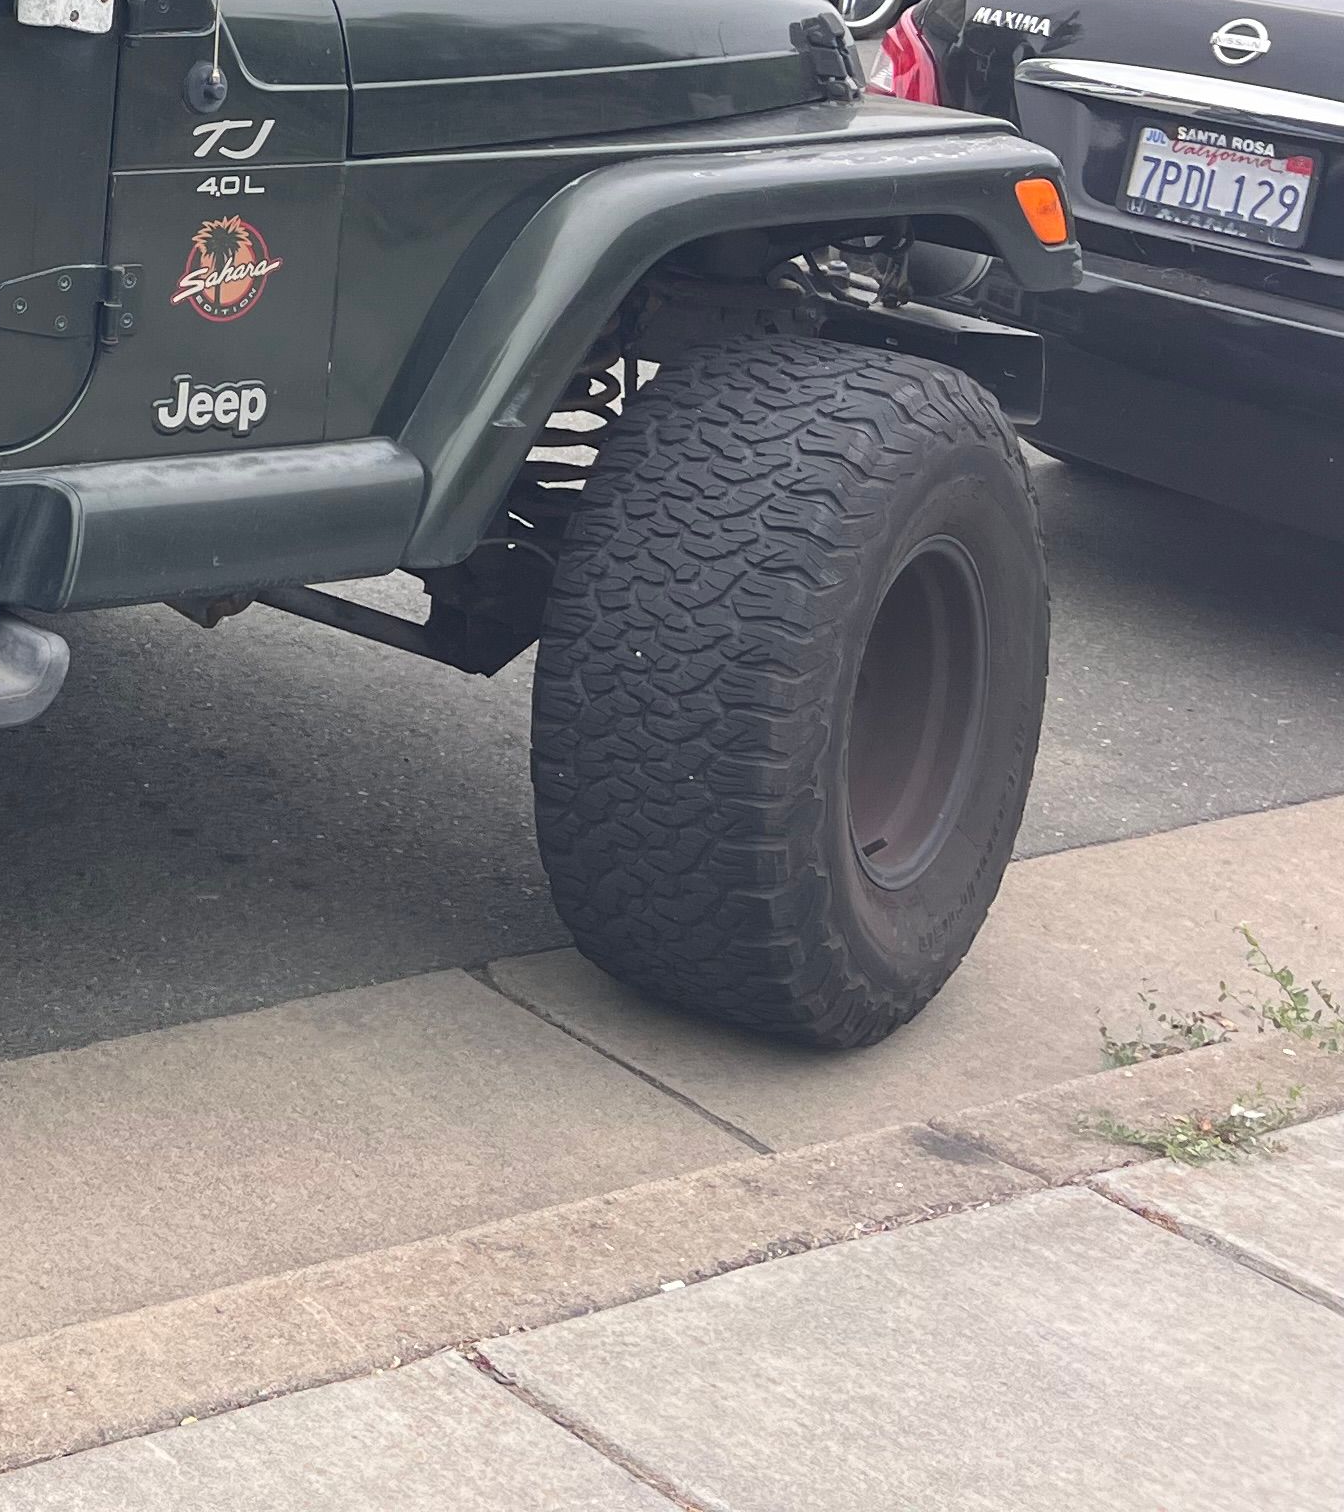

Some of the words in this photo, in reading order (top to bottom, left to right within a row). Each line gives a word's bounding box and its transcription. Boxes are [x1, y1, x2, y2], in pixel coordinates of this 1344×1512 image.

[972, 6, 1051, 37] MAXIMA
[1212, 35, 1263, 49] NISSAN
[192, 119, 276, 160] TJ
[1145, 129, 1166, 145] JUL
[1176, 126, 1227, 147] SANTA
[1231, 136, 1276, 158] ROSA
[1171, 140, 1284, 174] California
[1142, 156, 1300, 227] 7PDL129
[172, 256, 281, 303] Sahara
[195, 287, 258, 315] EDITION
[156, 378, 268, 432] Jeep
